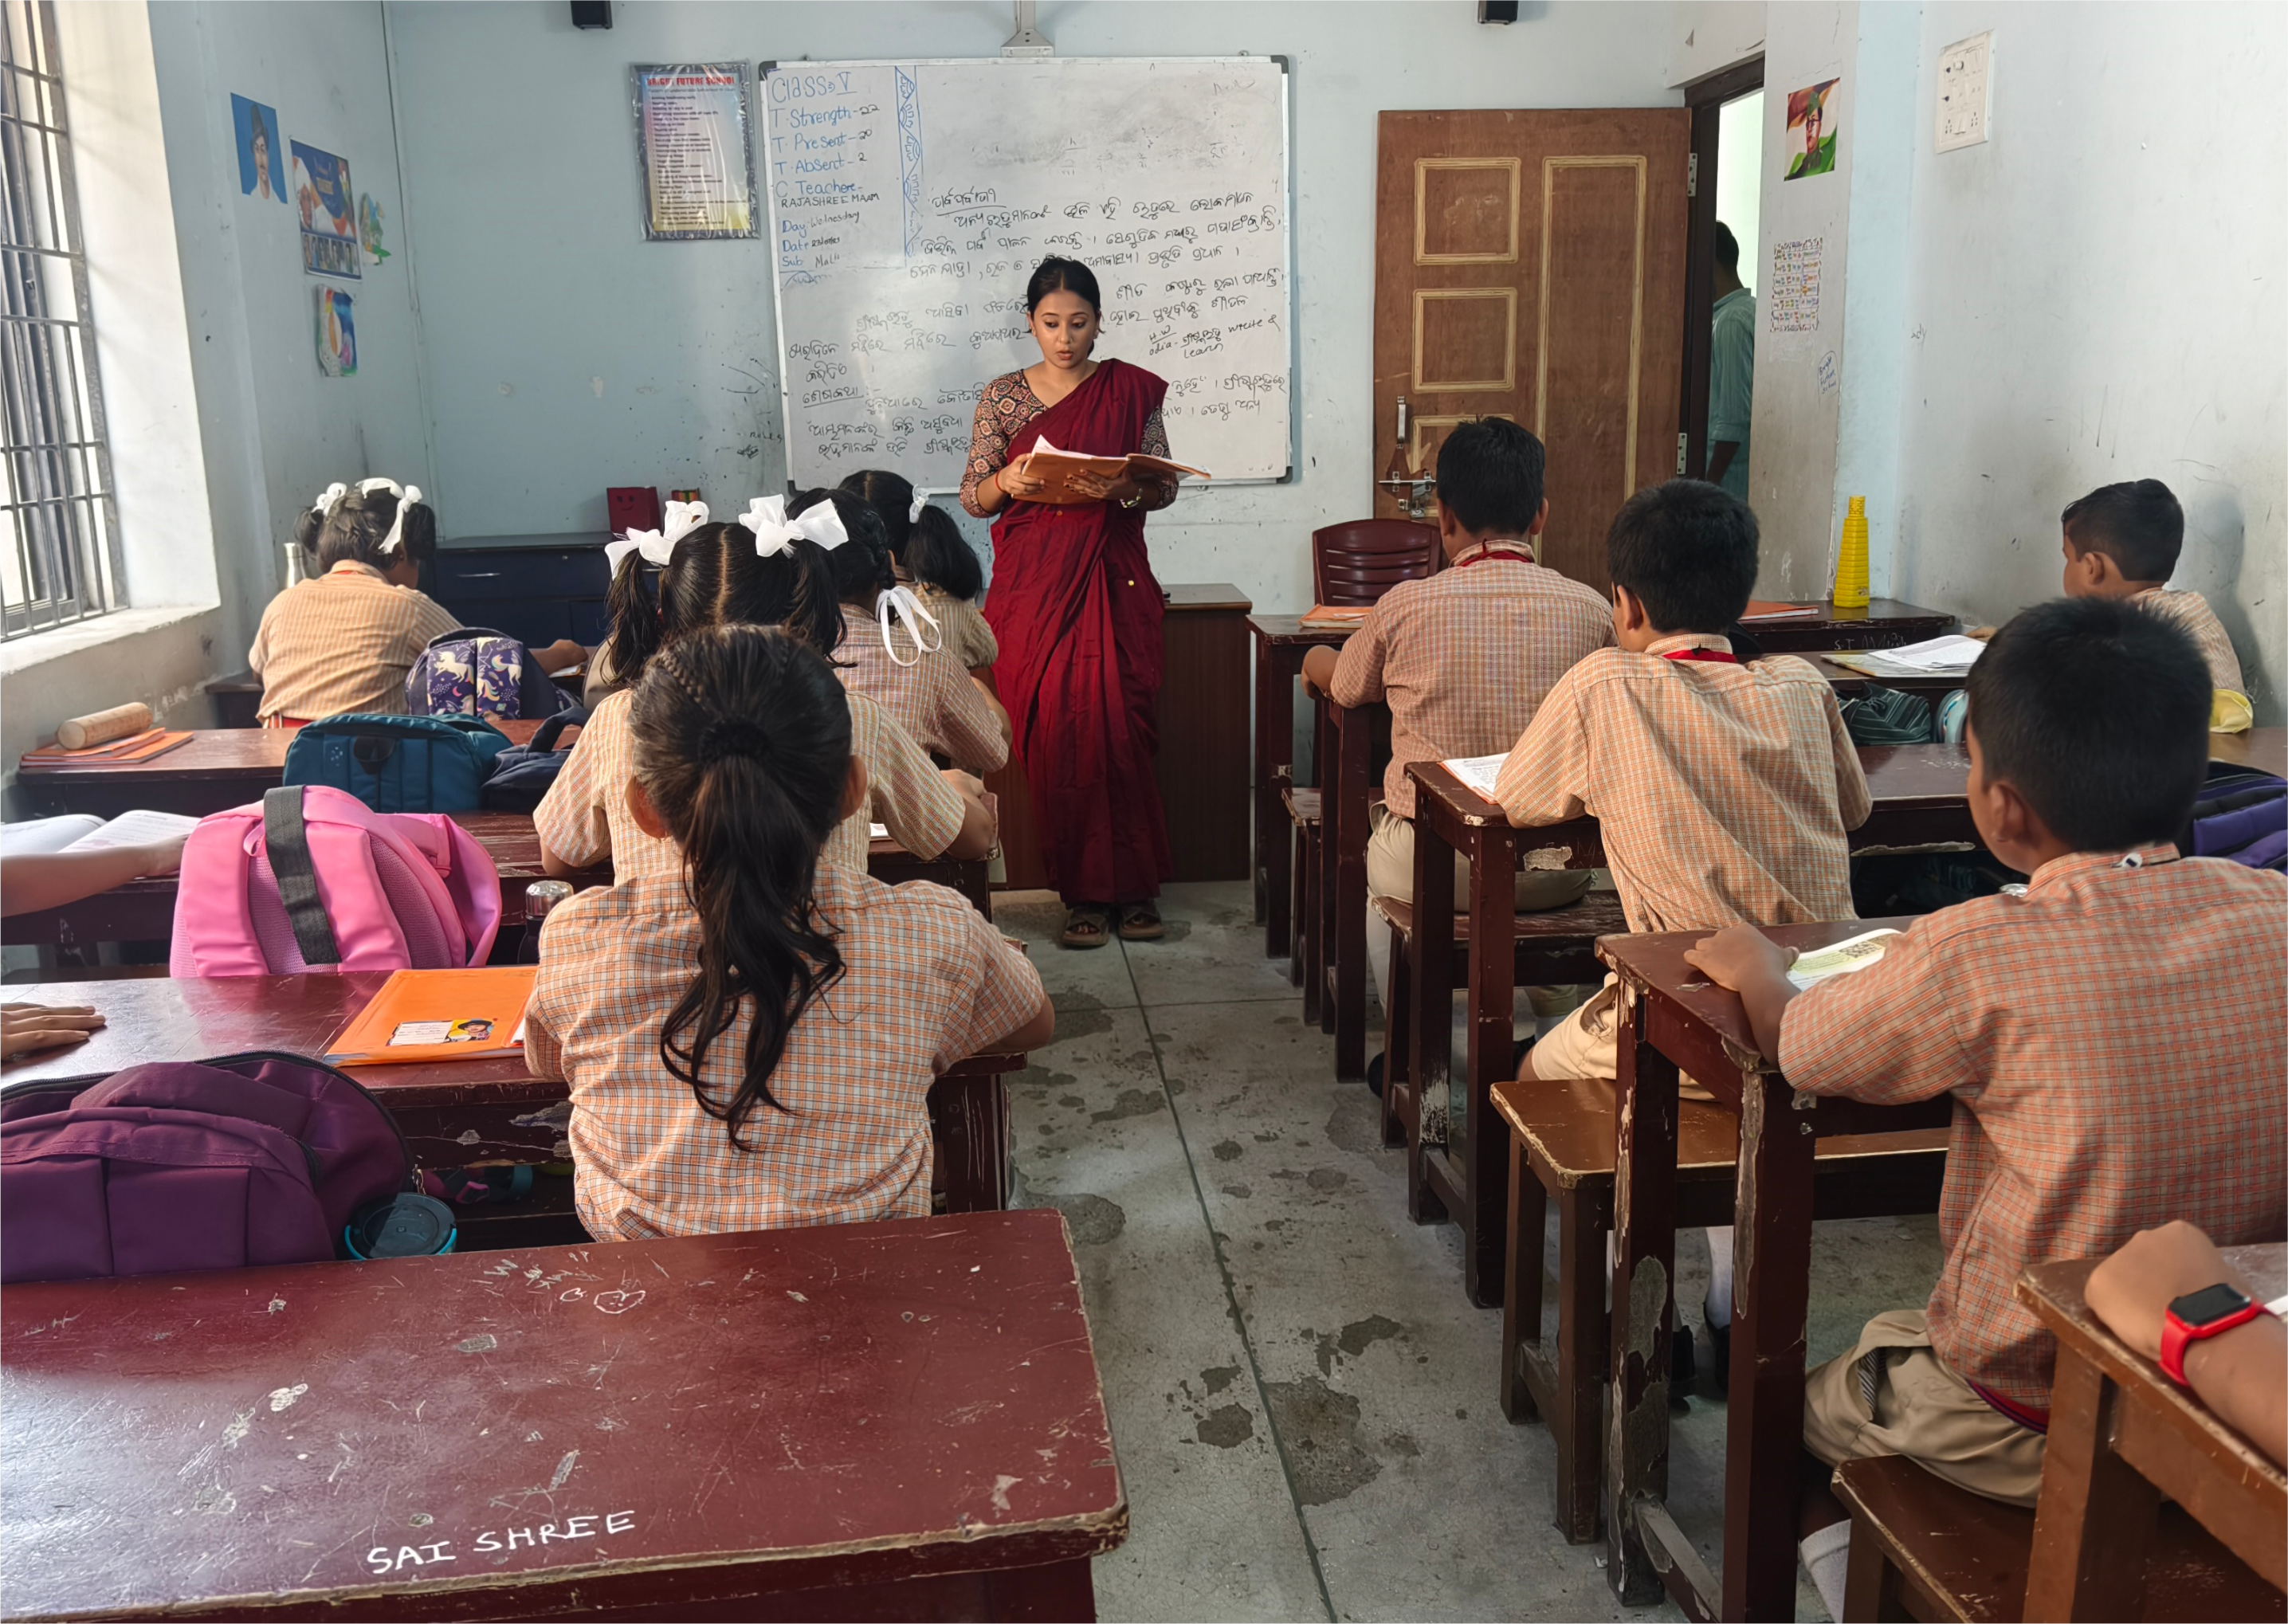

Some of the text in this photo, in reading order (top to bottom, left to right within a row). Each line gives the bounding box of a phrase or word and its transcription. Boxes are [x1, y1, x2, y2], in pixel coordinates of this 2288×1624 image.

[782, 195, 848, 208] RAJASHREE
[367, 1510, 635, 1575] SAI SHREE
